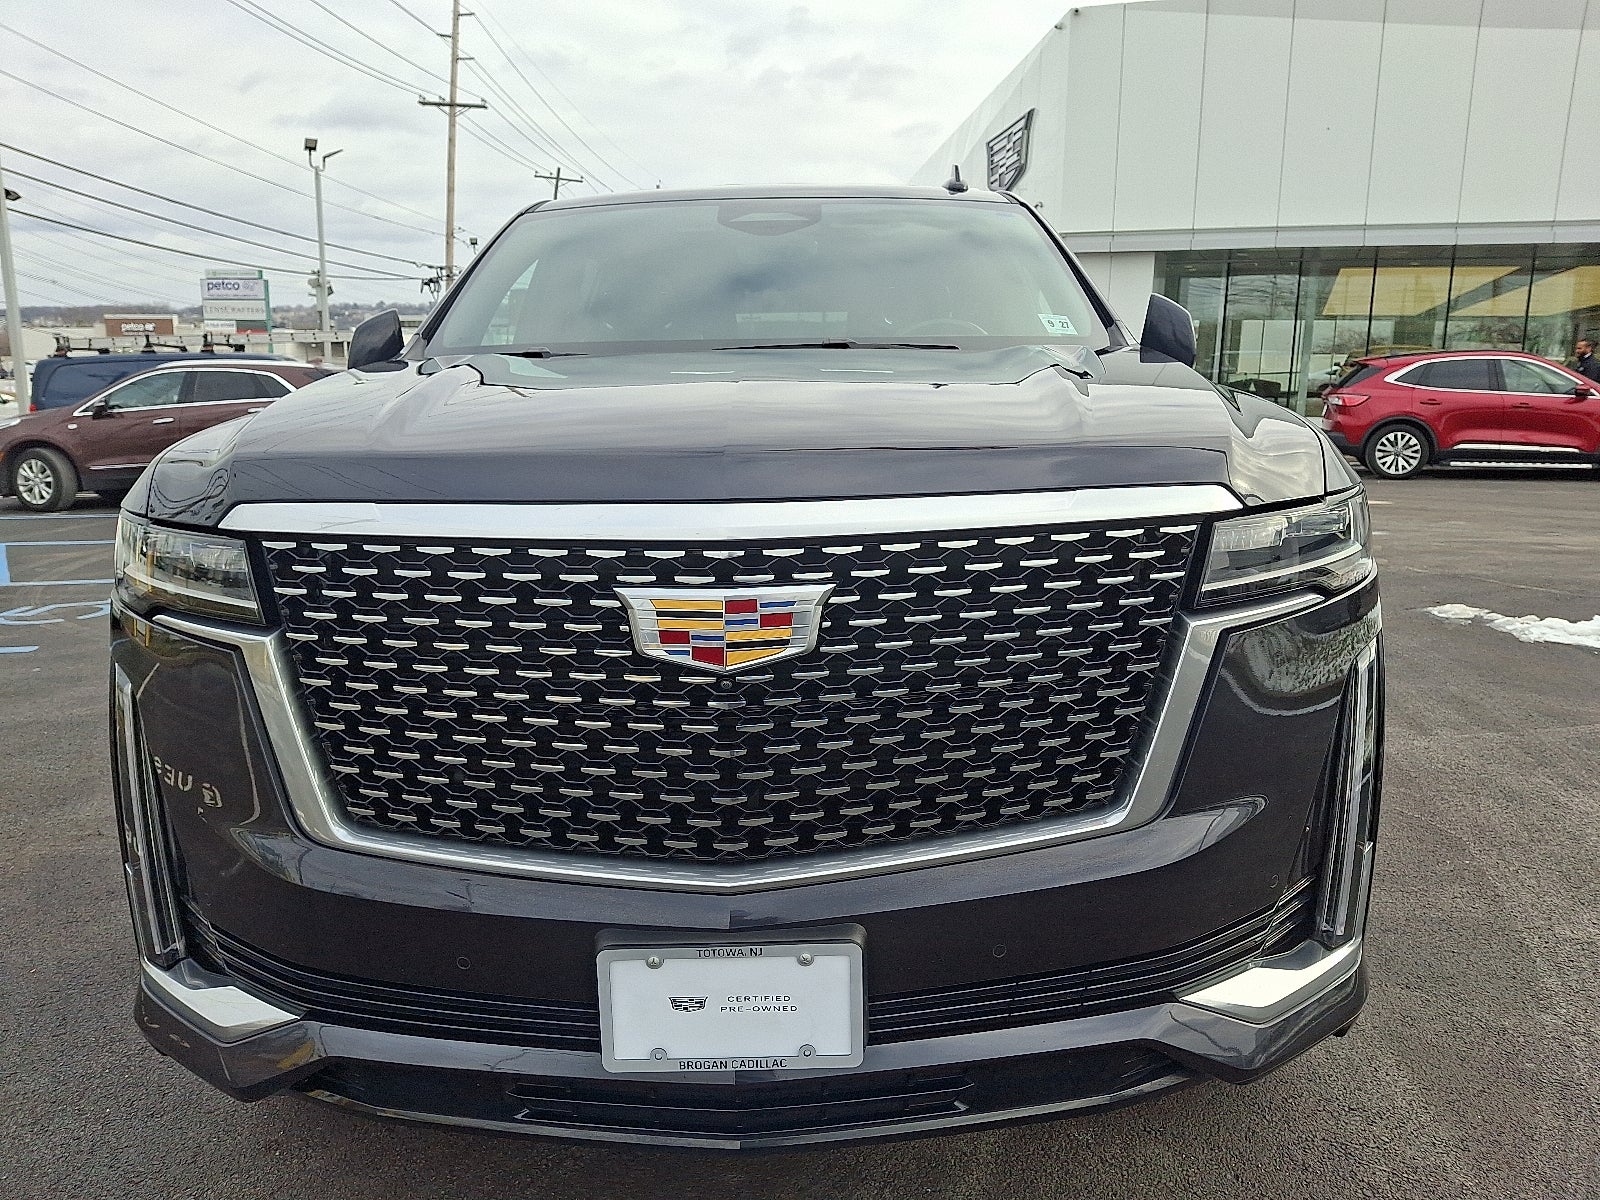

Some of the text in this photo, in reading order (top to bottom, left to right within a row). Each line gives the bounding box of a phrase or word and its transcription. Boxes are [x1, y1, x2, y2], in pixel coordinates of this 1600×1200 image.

[207, 281, 240, 291] petco
[1058, 320, 1070, 328] 27
[750, 947, 764, 957] NJ
[727, 995, 791, 1003] CERTIFIED
[720, 1004, 798, 1013] PRE-OWNED
[679, 1058, 788, 1070] BROGAN CADILLAC
